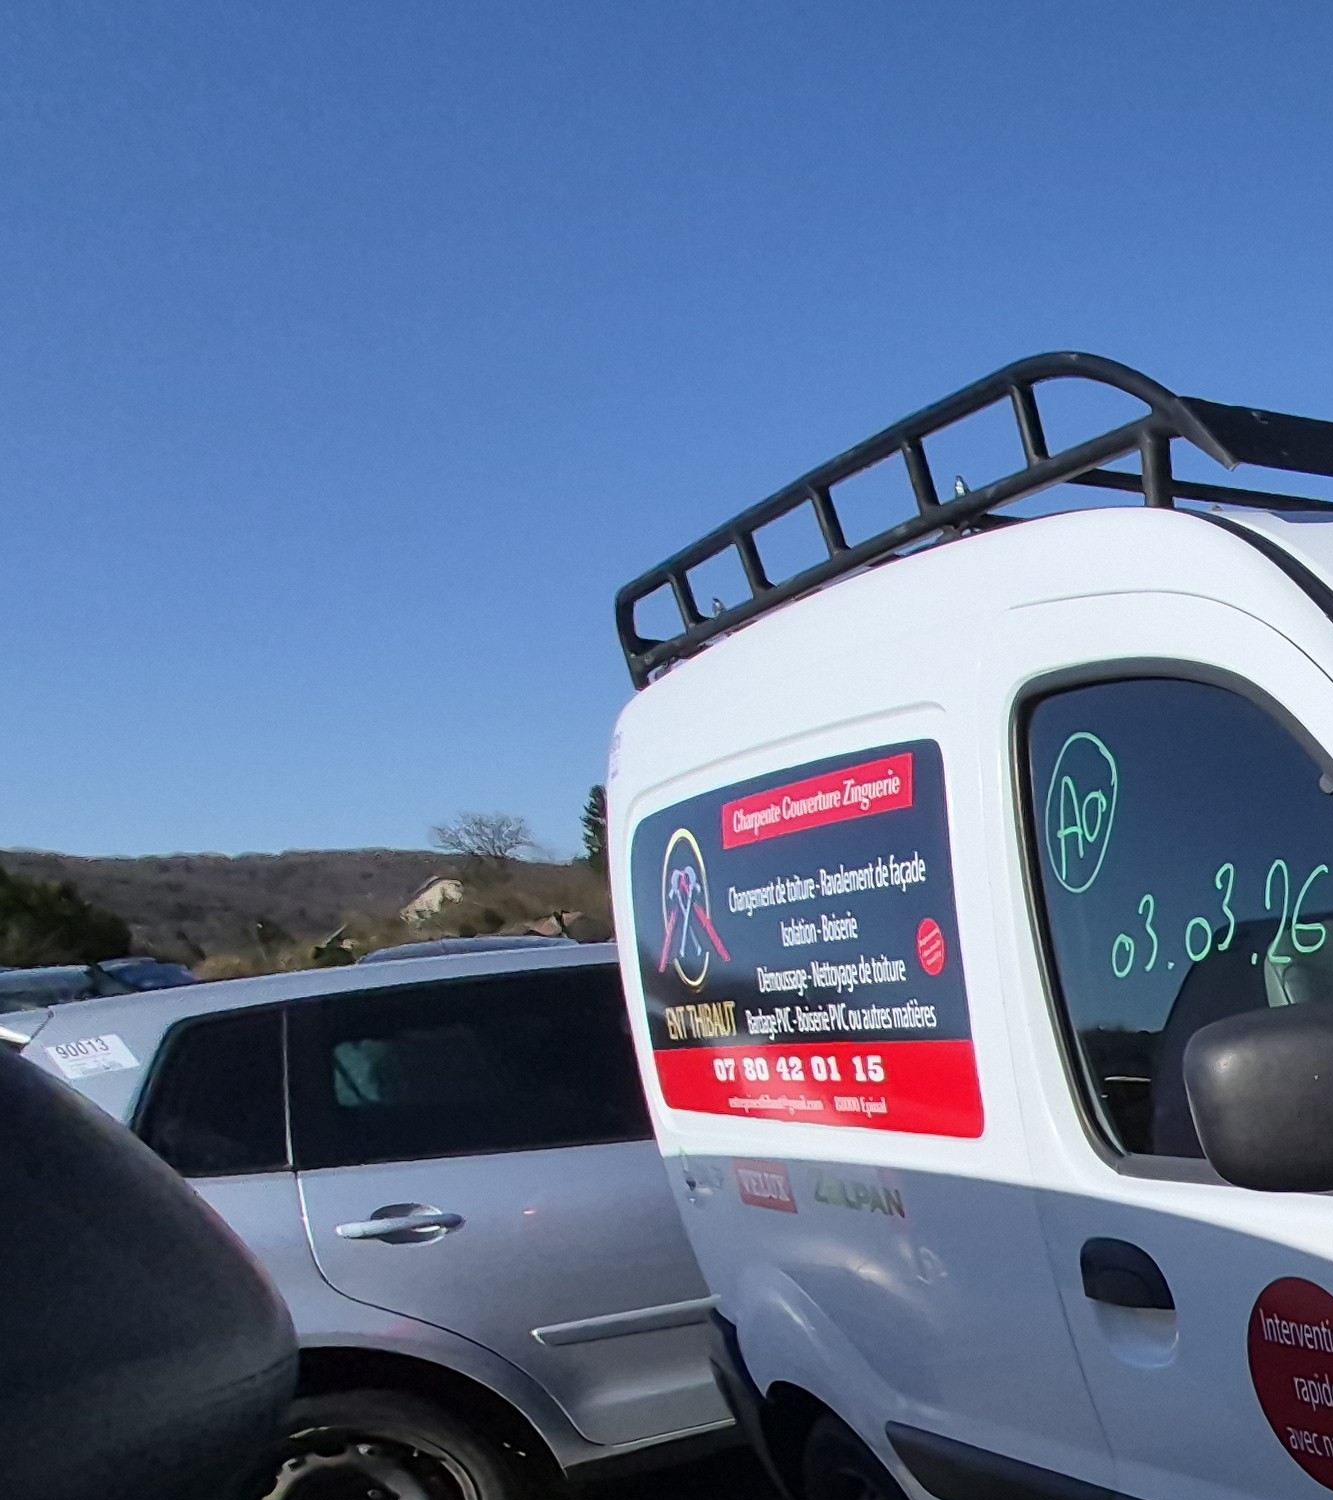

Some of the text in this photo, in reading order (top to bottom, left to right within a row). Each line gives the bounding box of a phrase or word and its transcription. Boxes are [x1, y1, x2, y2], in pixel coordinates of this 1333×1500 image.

[733, 769, 900, 836] Charpente Couverture Zinguerie
[728, 880, 775, 917] Changement
[776, 876, 787, 903] de
[786, 874, 815, 902] toiture
[819, 863, 875, 897] Ravalement
[875, 857, 889, 888] de
[889, 851, 926, 892] façade
[780, 917, 817, 947] Isolation
[821, 911, 859, 943] Boiserie
[757, 966, 809, 996] Démoussage
[810, 960, 858, 993] Nettoyage
[858, 955, 872, 984] de
[871, 954, 906, 983] toiture
[666, 1001, 737, 1040] ENT THIBAUT
[774, 1006, 795, 1033] PVC
[796, 1005, 831, 1033] Boiserie
[829, 1003, 849, 1031] PVC
[848, 1009, 862, 1030] ou
[862, 1003, 893, 1030] autres
[892, 998, 937, 1029] matières
[55, 1038, 109, 1059] 90013
[713, 1055, 885, 1082] 07 80 42 01 15
[1286, 1426, 1324, 1457] avec
